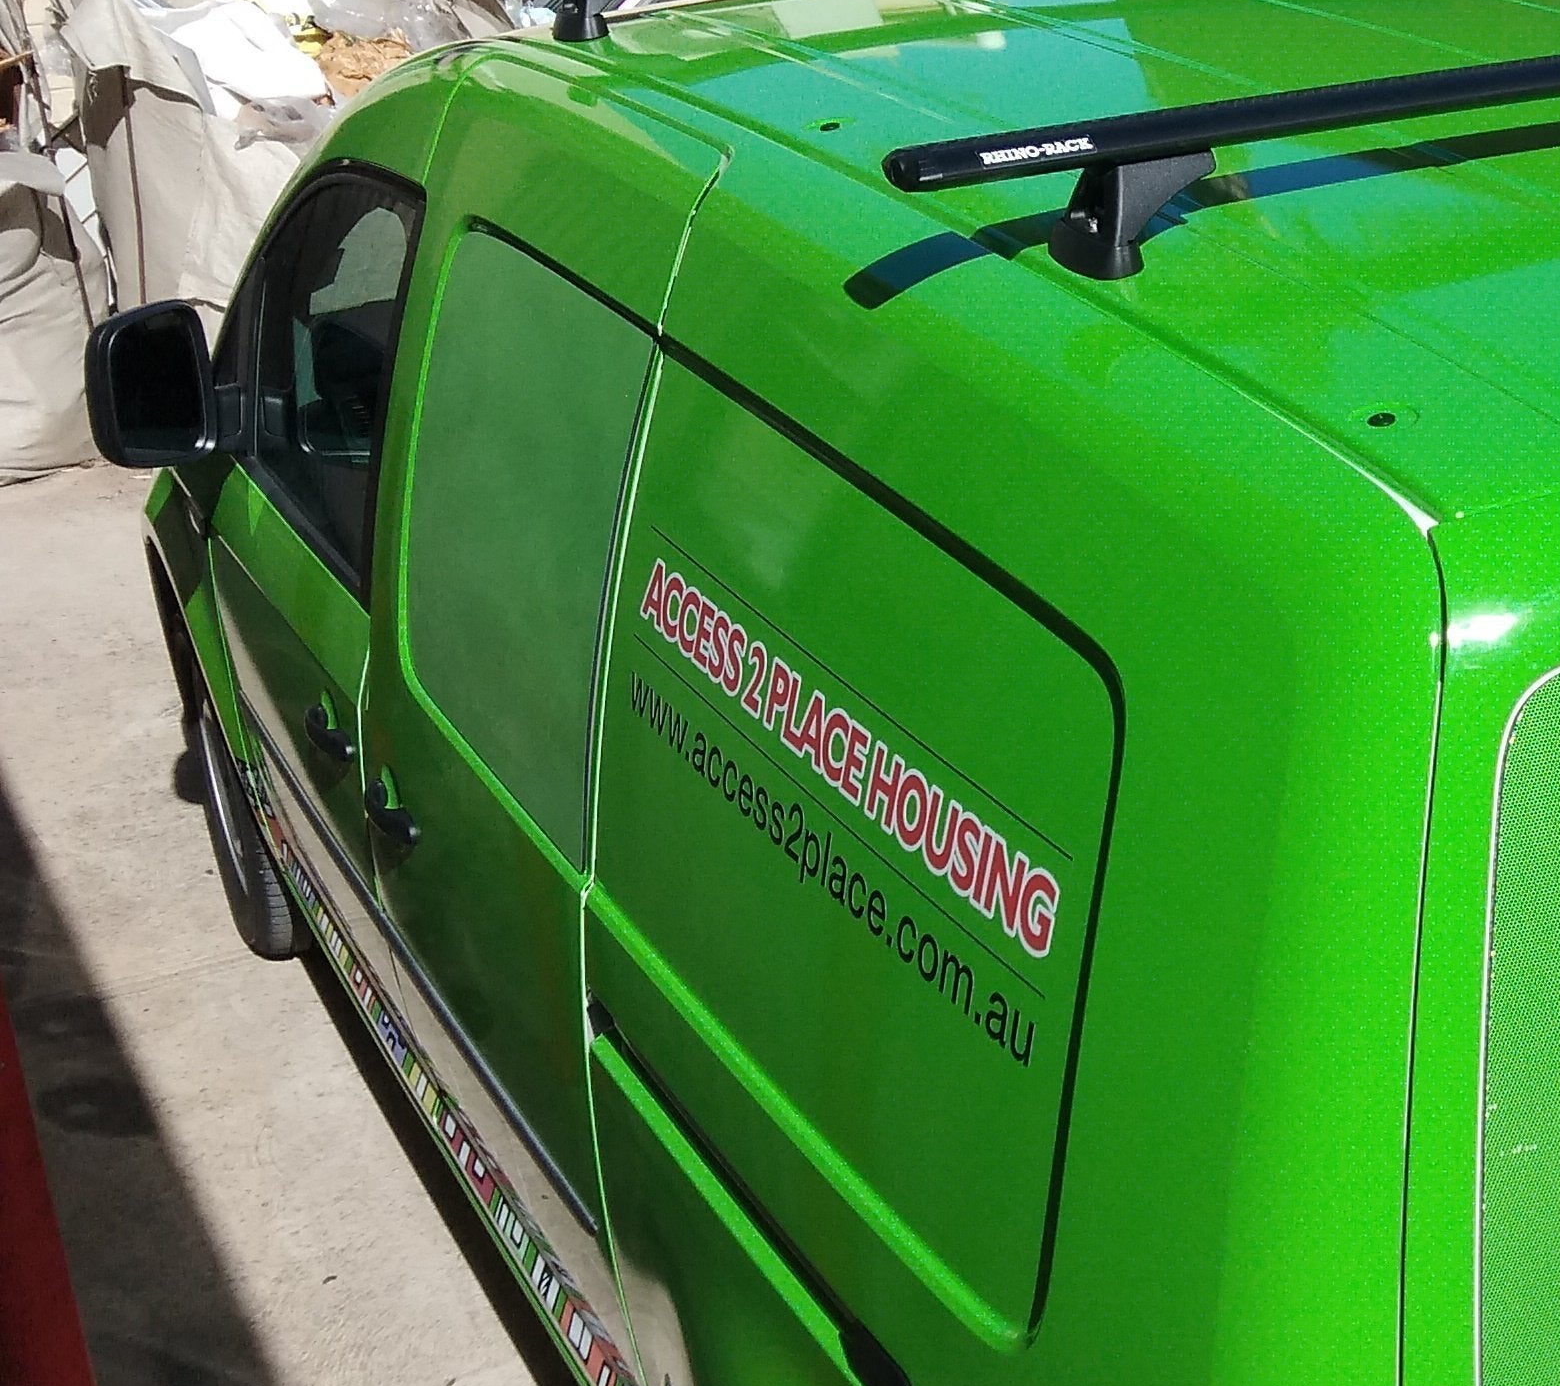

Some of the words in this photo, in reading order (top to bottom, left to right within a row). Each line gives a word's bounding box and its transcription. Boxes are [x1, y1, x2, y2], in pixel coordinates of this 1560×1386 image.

[979, 136, 1094, 166] RHINO-RACK
[629, 670, 1036, 1067] www.access2place.com.au
[640, 558, 746, 697] ACCESS
[740, 641, 767, 719] 2
[763, 661, 872, 808] PLACE
[863, 741, 1060, 958] HOUSING
